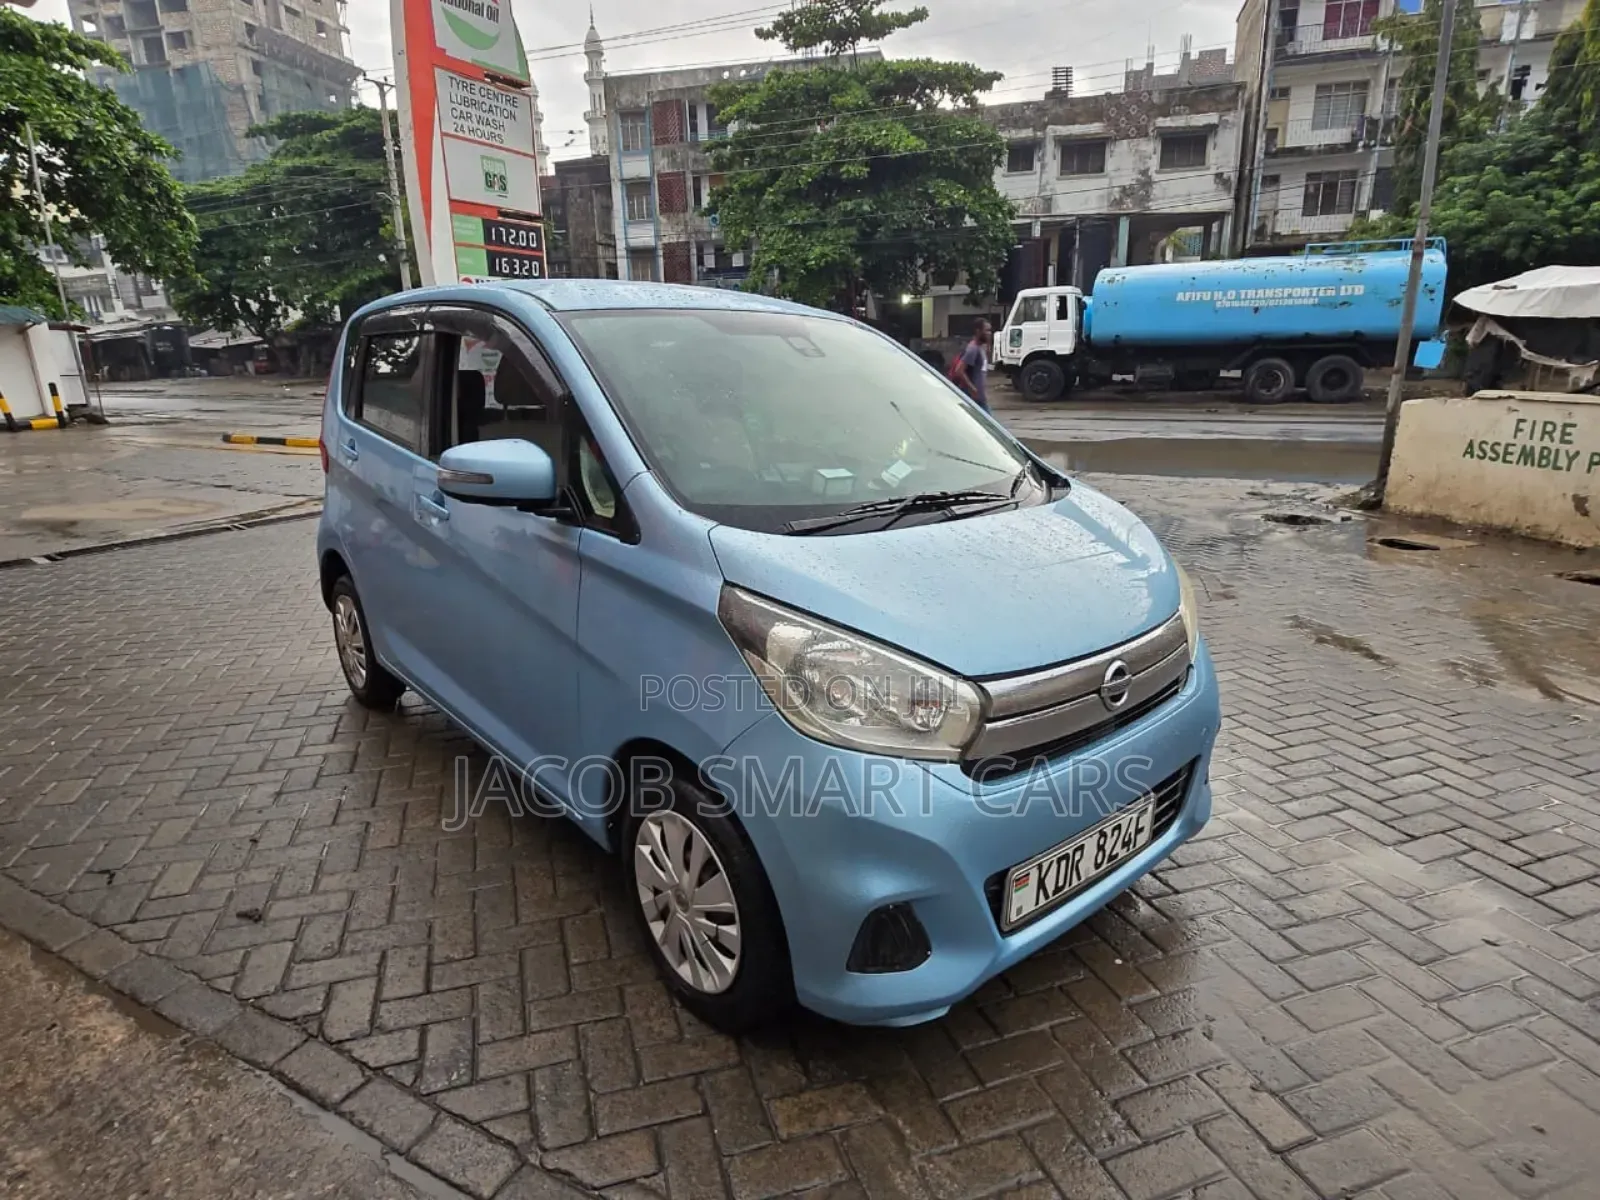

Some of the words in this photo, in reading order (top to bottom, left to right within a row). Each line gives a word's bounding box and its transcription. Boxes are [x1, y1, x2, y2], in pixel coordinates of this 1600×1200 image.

[440, 0, 484, 18] ational
[486, 4, 500, 24] Oil
[449, 76, 475, 98] TYRE
[479, 87, 519, 108] CENTRE
[449, 92, 517, 122] LUBRICATION
[451, 107, 473, 124] CAR
[475, 113, 506, 132] WASH
[453, 121, 466, 134] 24
[468, 125, 505, 145] HOURS
[1340, 284, 1365, 296] LTD
[1513, 418, 1578, 445] FIRE
[1462, 438, 1581, 472] ASSEMBLY
[1034, 843, 1086, 907] KDR
[1094, 807, 1150, 871] 824F
